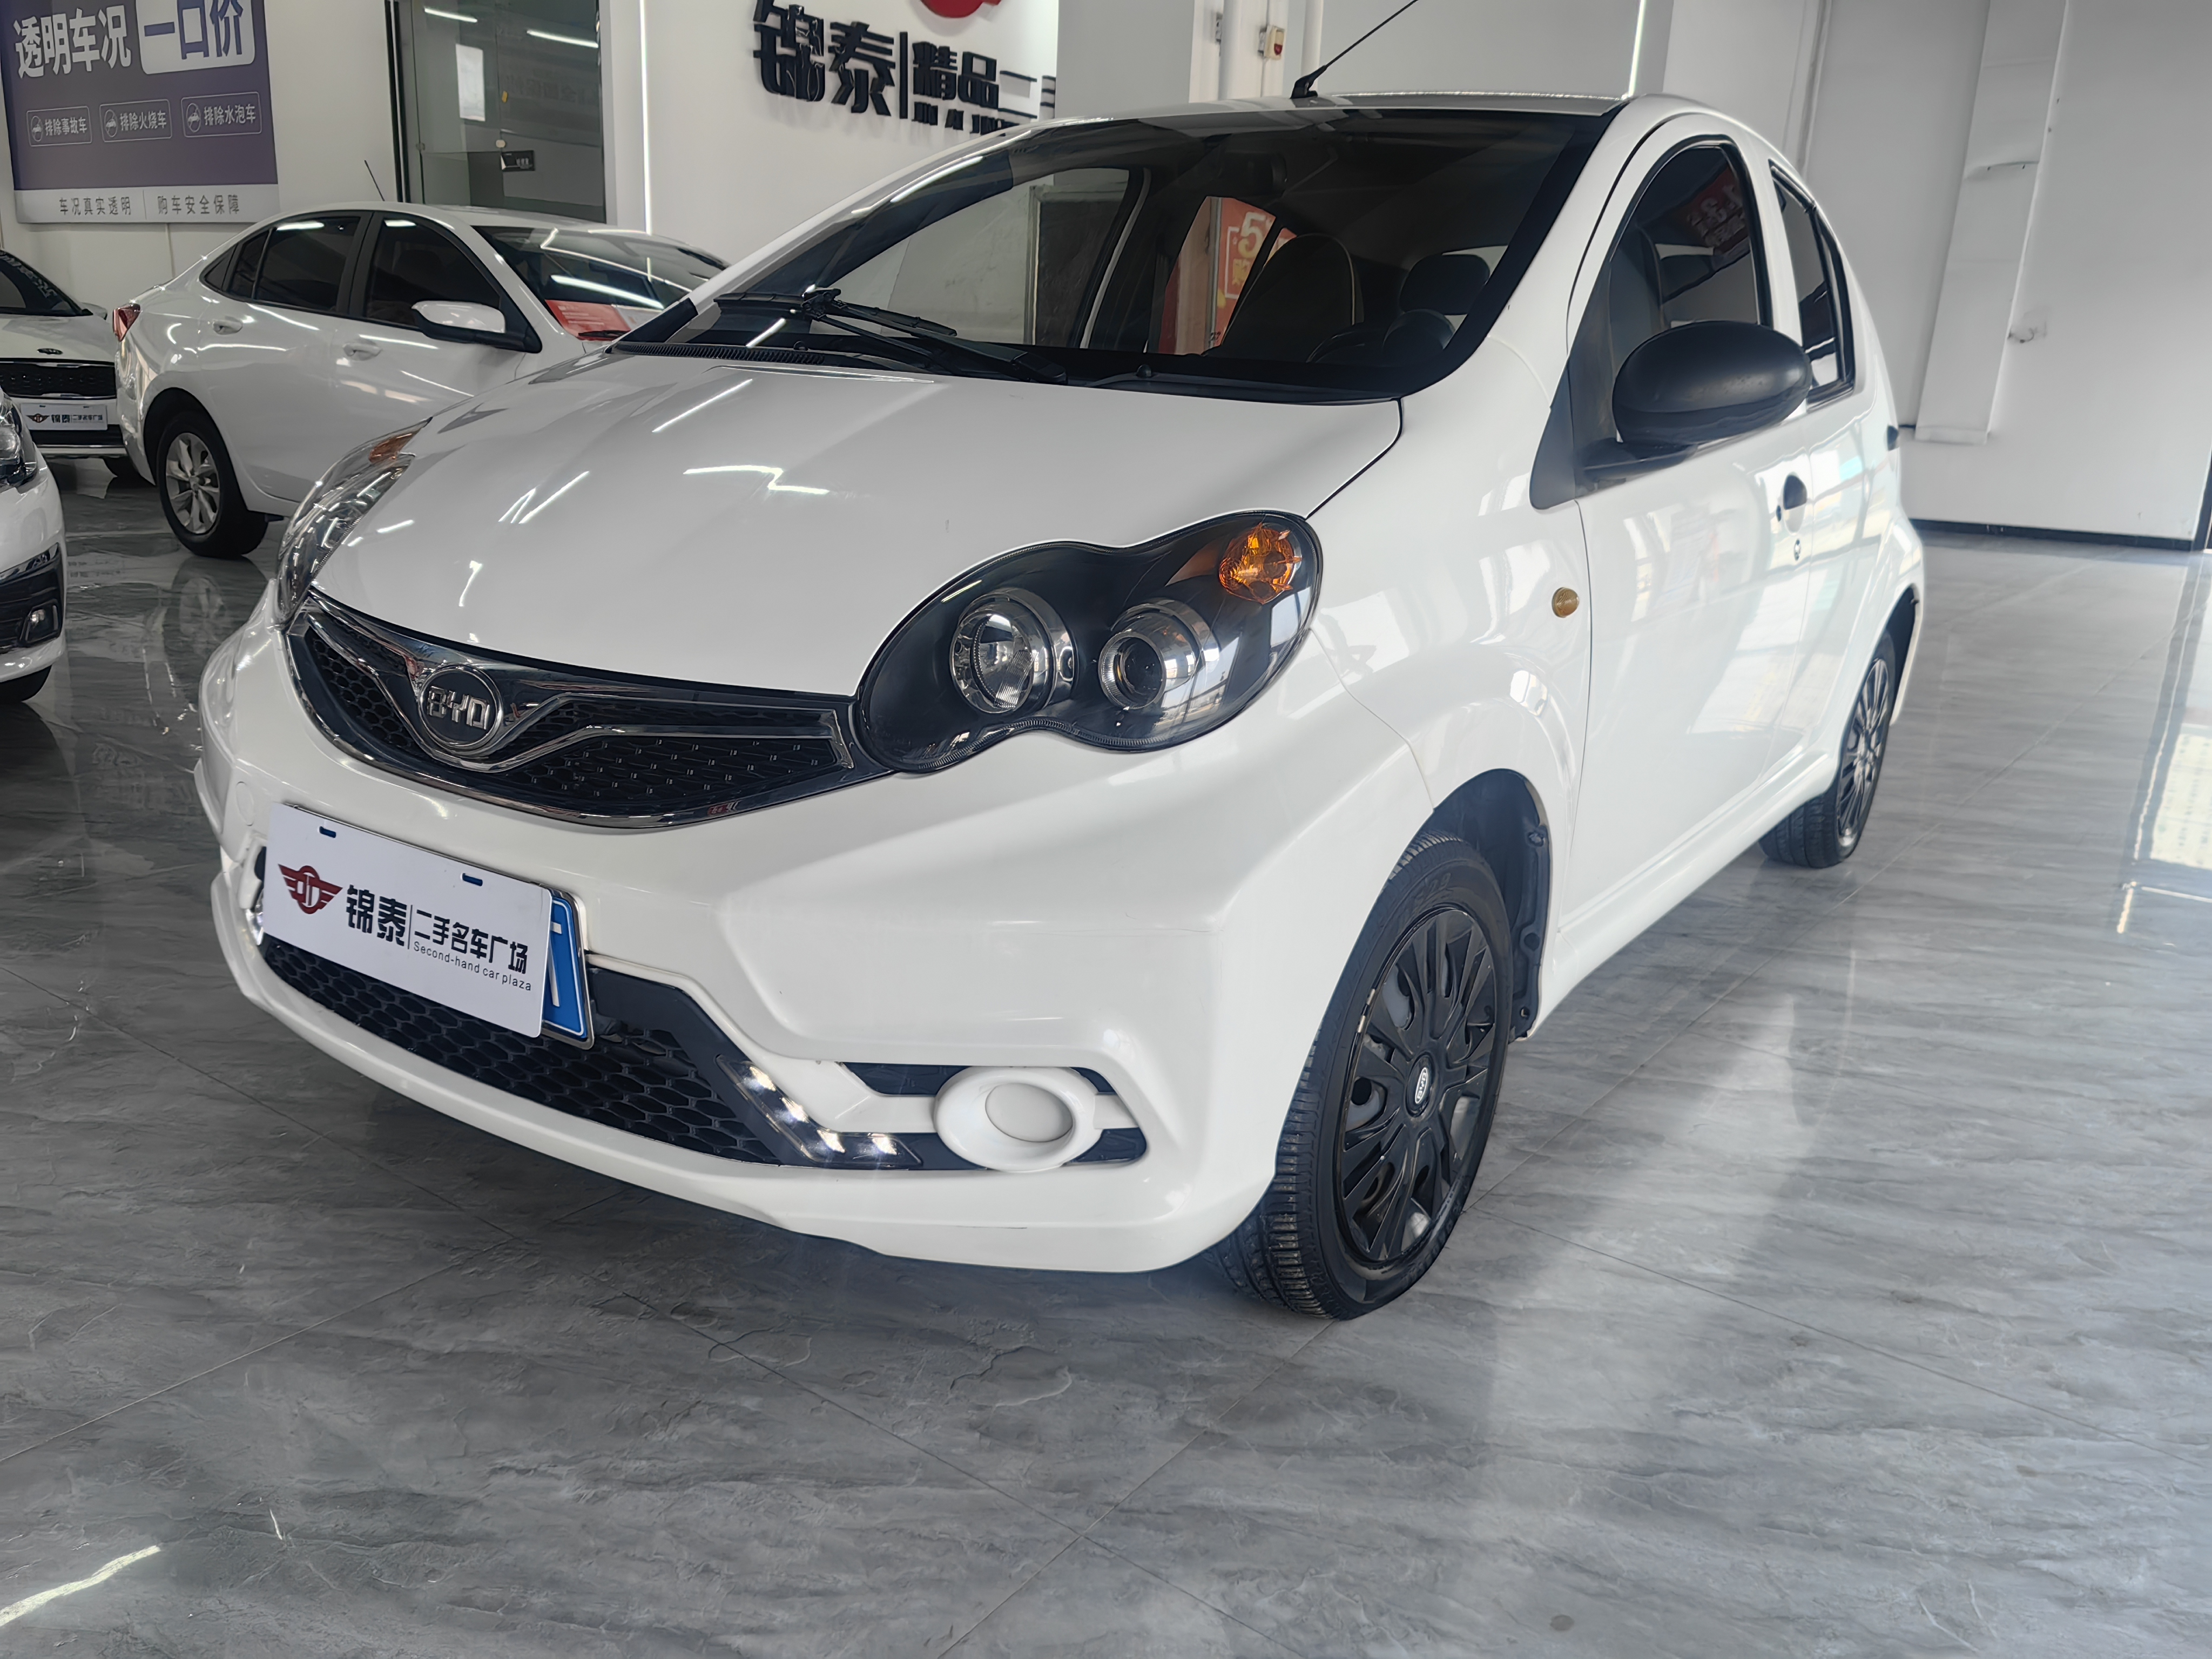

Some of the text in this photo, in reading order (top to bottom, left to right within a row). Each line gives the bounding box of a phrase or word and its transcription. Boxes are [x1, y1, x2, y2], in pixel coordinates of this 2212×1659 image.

[13, 0, 244, 79] 透明车况 一口价
[753, 0, 895, 116] 锦泰
[45, 117, 87, 136] 排除事故车
[120, 110, 167, 131] 排除火烧车
[204, 104, 256, 126] 排除水泡车
[59, 194, 239, 215] 车况真实透明 购车安全保障
[346, 884, 407, 947] 锦泰
[414, 909, 528, 974] 二手名车广场
[413, 941, 532, 992] Second-hand car plaza
